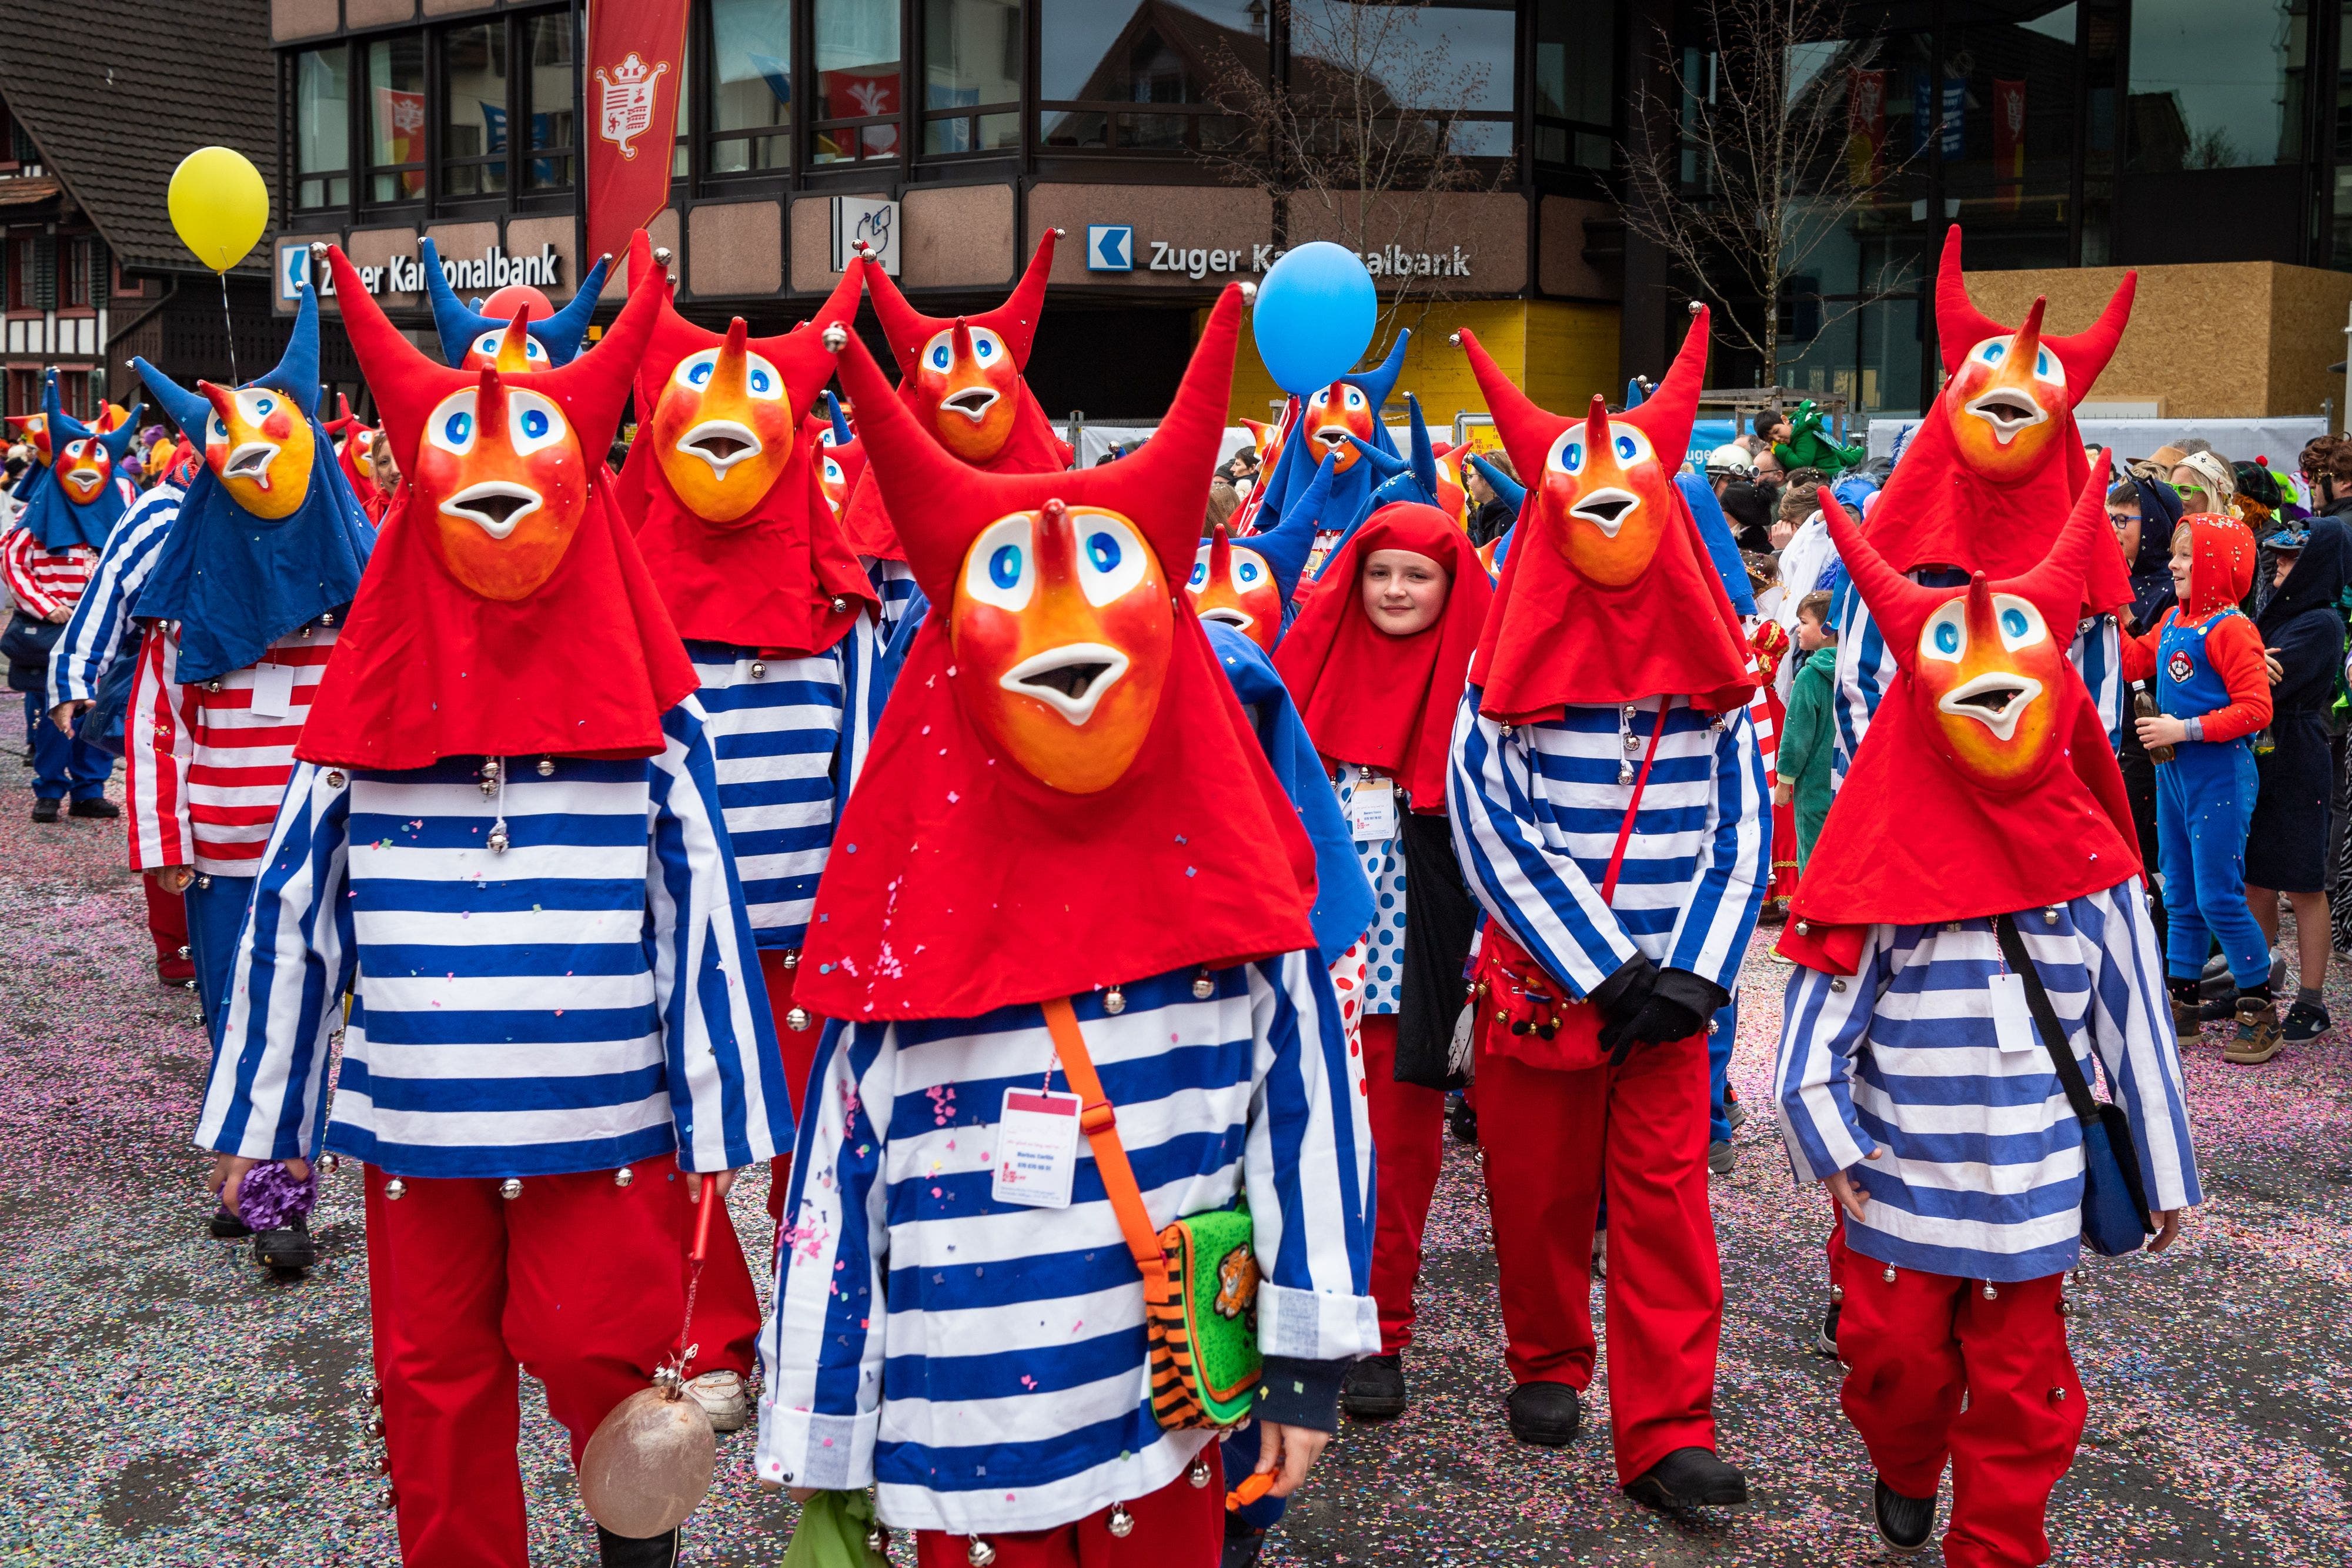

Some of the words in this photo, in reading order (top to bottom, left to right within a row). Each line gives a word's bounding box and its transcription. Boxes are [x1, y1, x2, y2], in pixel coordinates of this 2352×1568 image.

[320, 260, 383, 296] Zer
[1150, 242, 1241, 280] Zuger
[1685, 449, 1712, 464] uge
